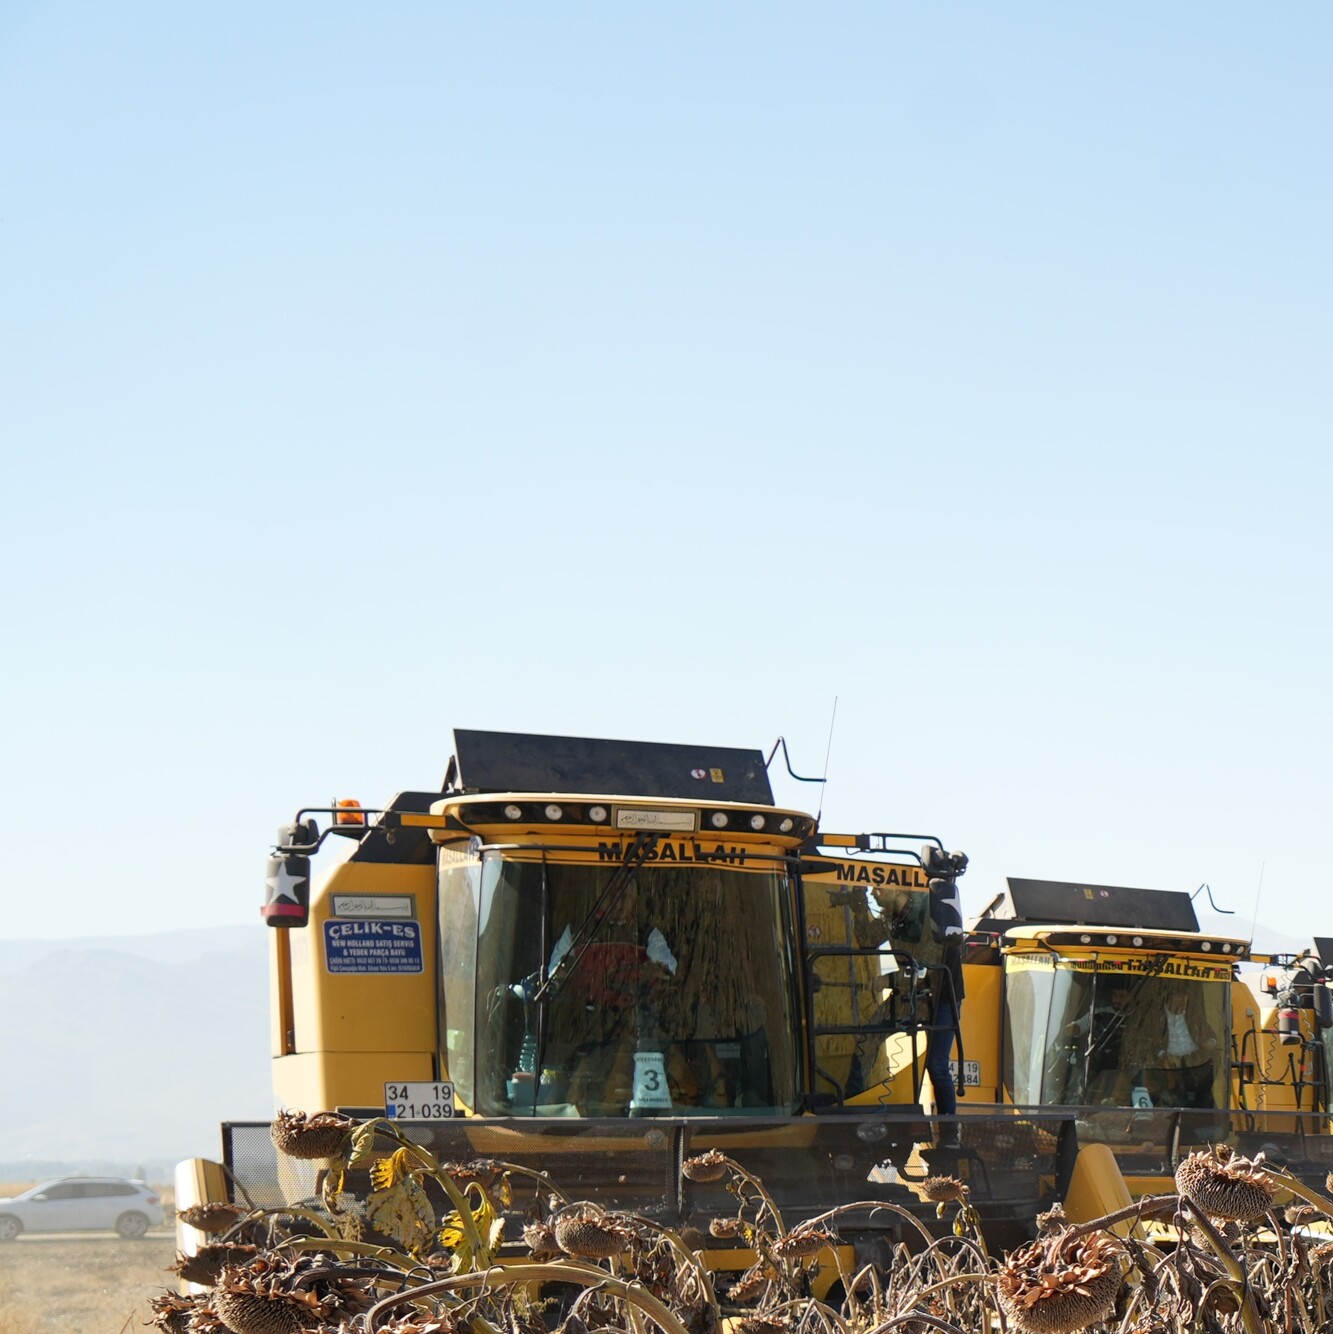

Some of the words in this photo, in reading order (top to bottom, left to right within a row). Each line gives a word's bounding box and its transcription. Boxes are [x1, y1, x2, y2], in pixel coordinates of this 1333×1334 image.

[329, 922, 416, 939] ÇELİK-ES
[332, 940, 346, 948] NEW
[347, 940, 375, 948] HOLLAND
[370, 949, 390, 958] PARÇA
[967, 1063, 978, 1072] 19
[644, 1069, 660, 1091] 3
[387, 1085, 409, 1101] 34
[432, 1085, 452, 1101] 19
[397, 1104, 415, 1118] 21
[421, 1104, 452, 1118] 039
